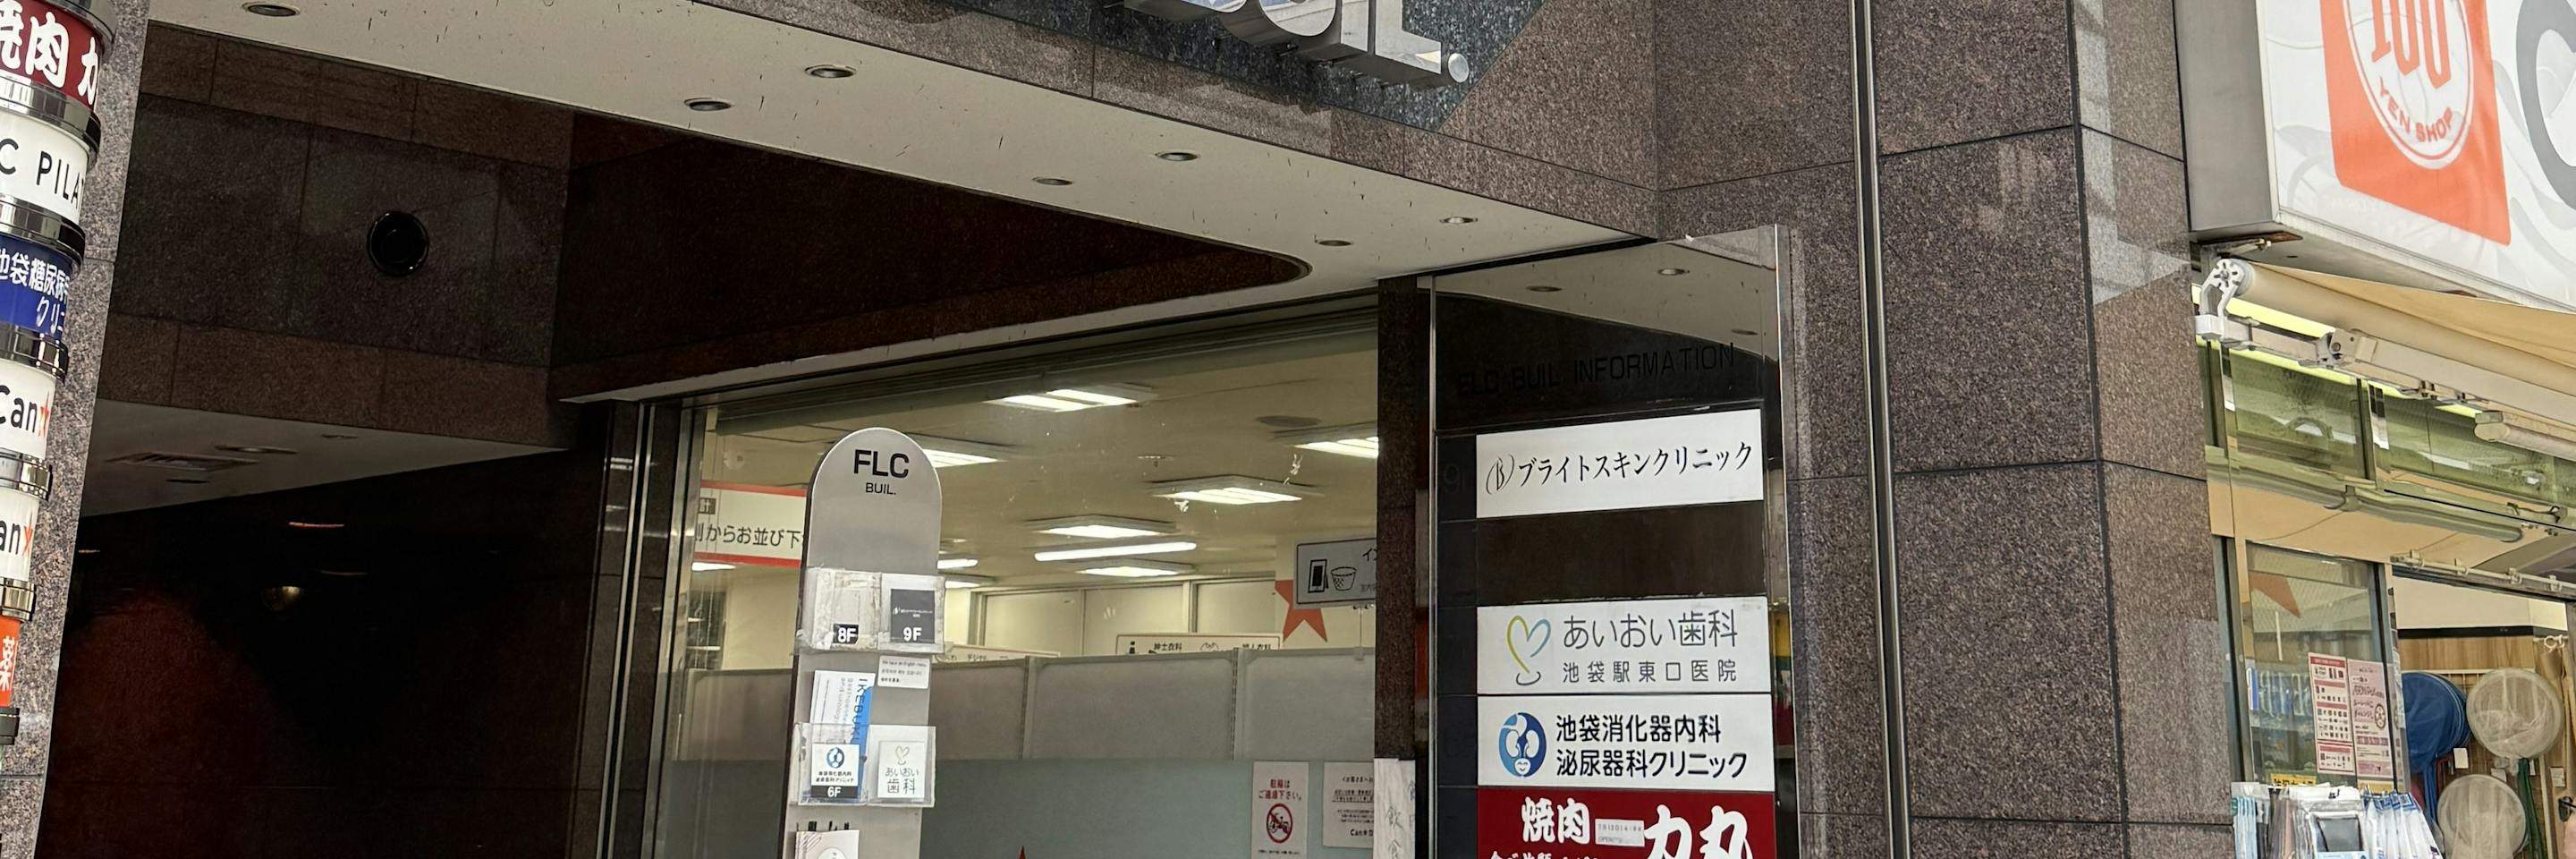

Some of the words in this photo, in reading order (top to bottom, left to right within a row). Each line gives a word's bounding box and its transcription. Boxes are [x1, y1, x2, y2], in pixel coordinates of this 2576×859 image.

[2379, 76, 2411, 134] YEN
[2416, 107, 2453, 143] SHOP
[1572, 343, 1734, 385] INFORMATION
[854, 449, 910, 479] FLC
[1519, 441, 1752, 488] ブライトスキンクリニック
[866, 482, 896, 496] BUIL.
[837, 627, 857, 642] 8F
[902, 626, 922, 642] 9F
[1563, 609, 1738, 650] あいおい歯科
[1563, 659, 1737, 684] 池袋駅東口医院
[1556, 714, 1721, 744] 池袋消化器内科
[885, 767, 919, 777] あいおい
[1556, 749, 1748, 778] 泌尿器科クリニック
[827, 786, 842, 797] 6F
[886, 778, 916, 795] 歯科
[1521, 796, 1590, 845] 焼肉
[1644, 804, 1754, 859] 力丸
